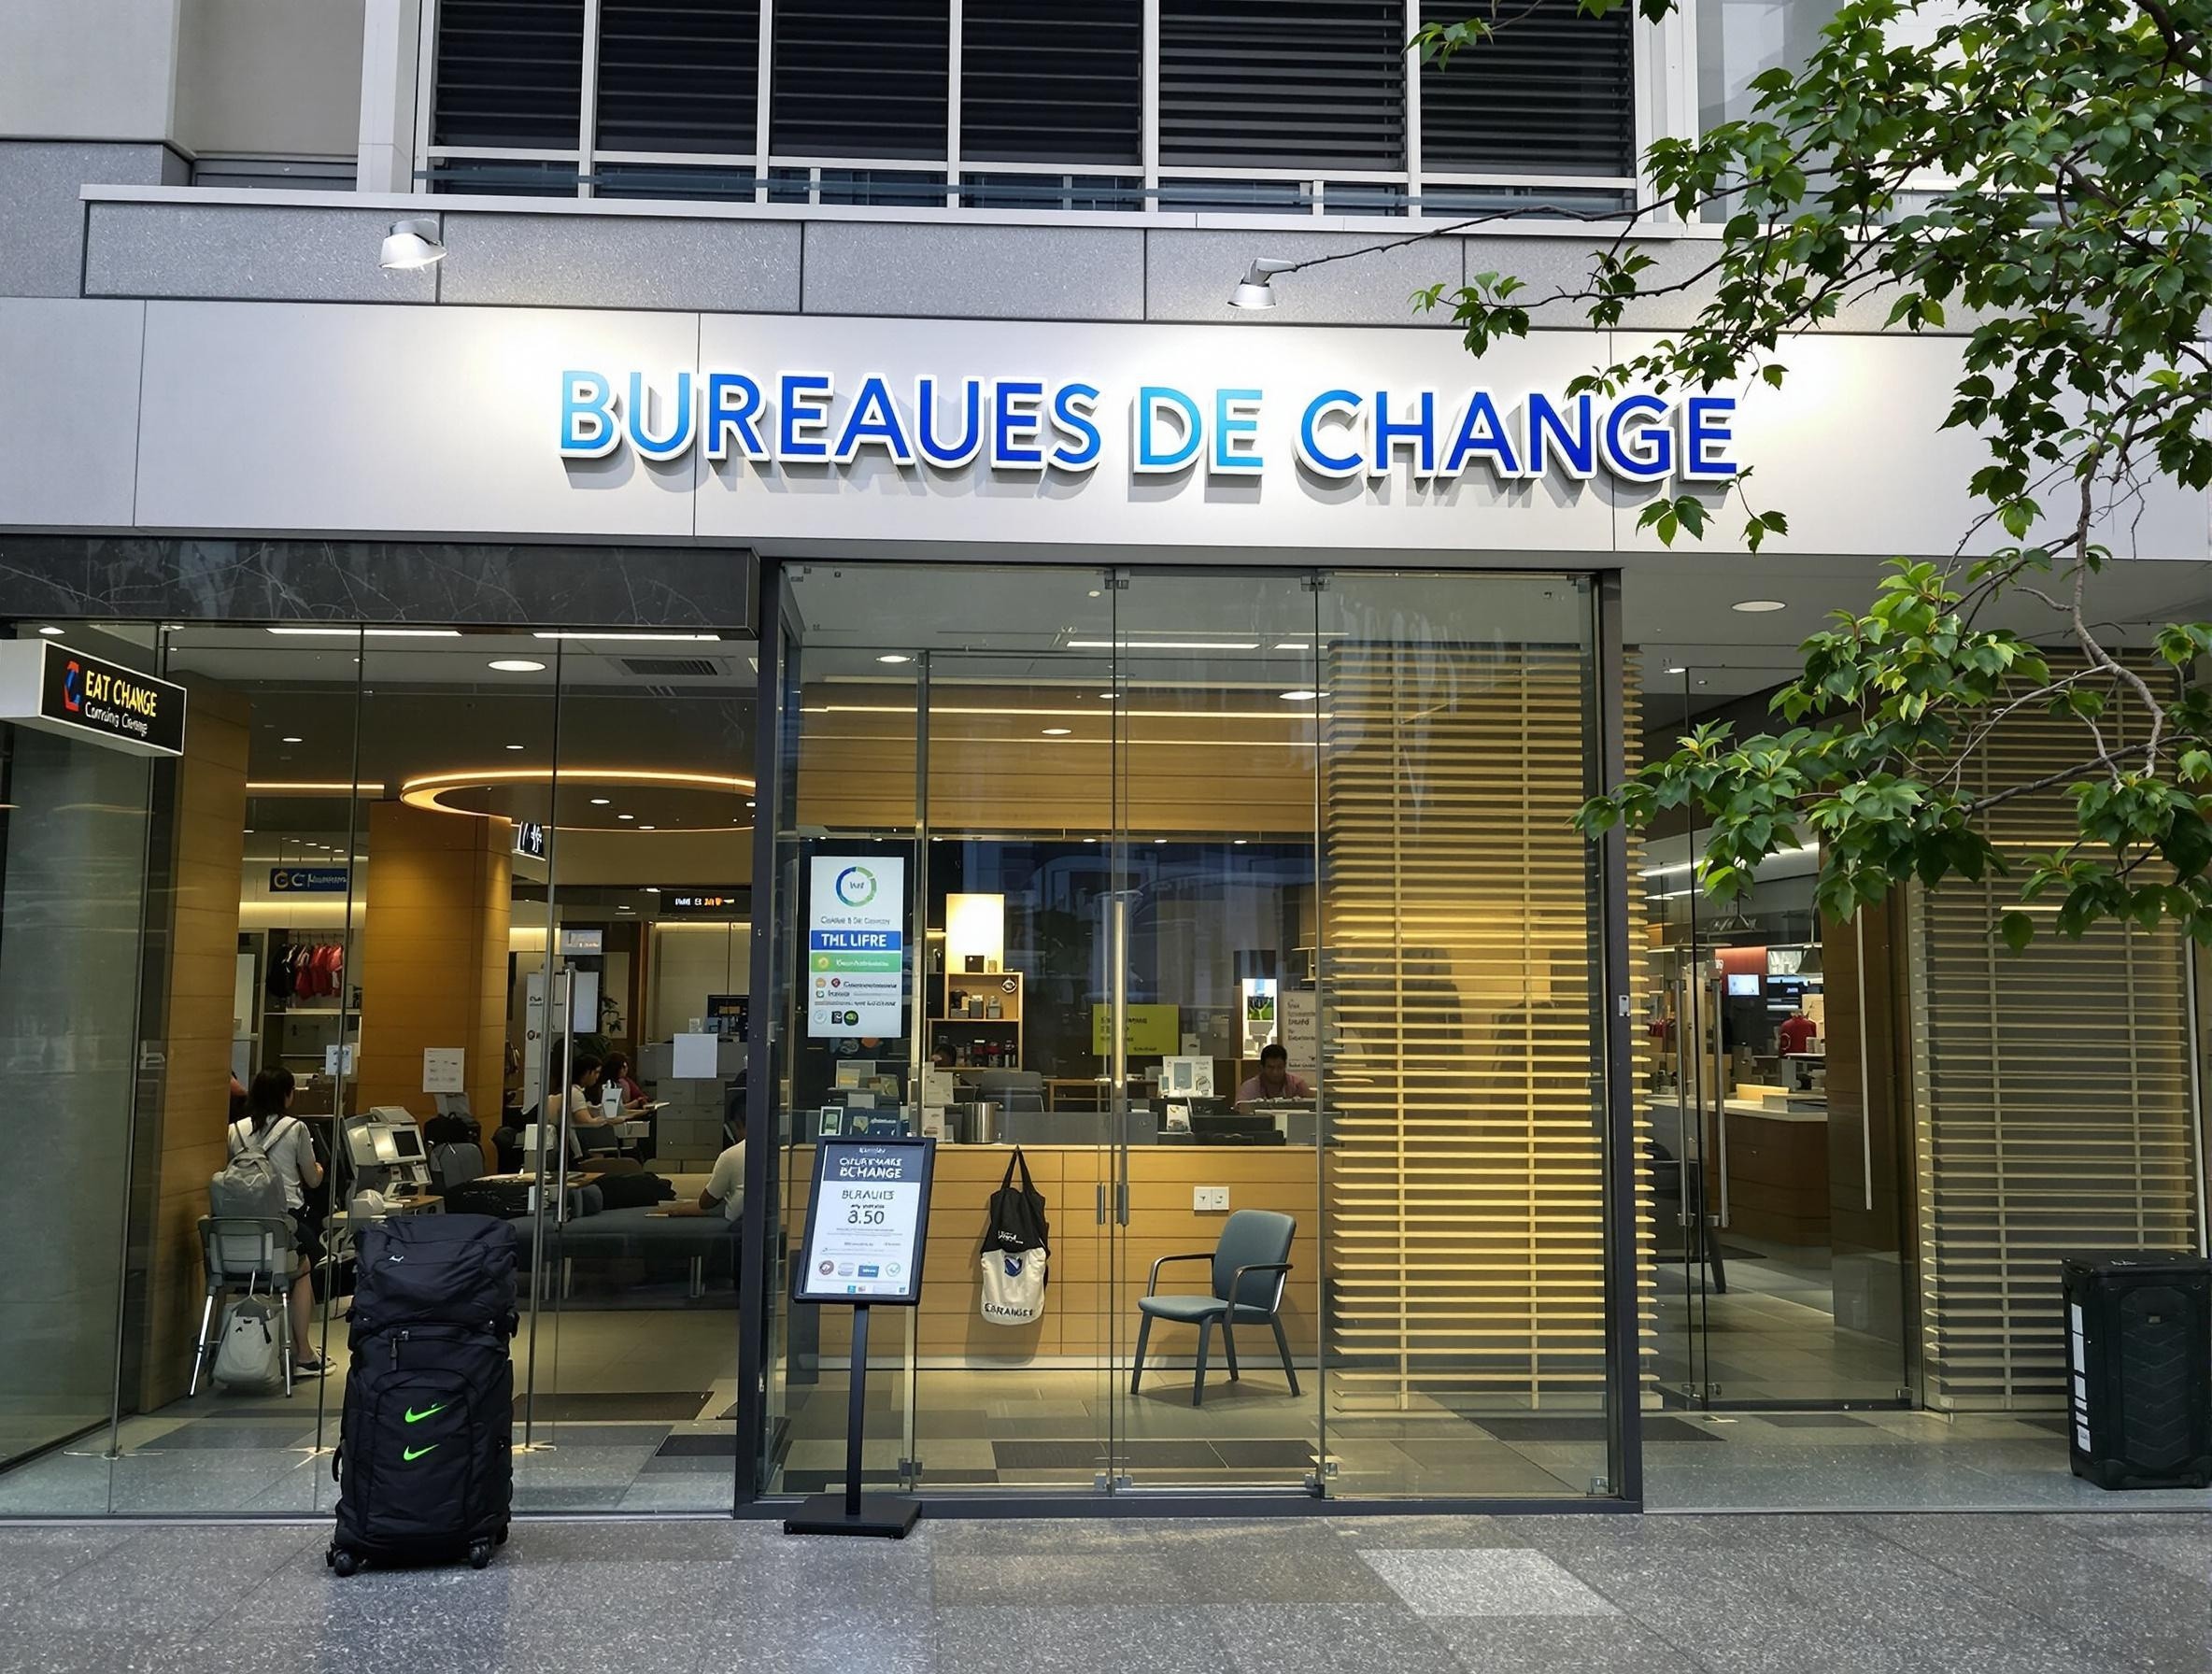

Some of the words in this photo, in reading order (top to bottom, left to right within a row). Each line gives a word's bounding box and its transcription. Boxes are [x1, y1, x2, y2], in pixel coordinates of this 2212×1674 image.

[560, 370, 1102, 465] BUREAUES
[1138, 385, 1264, 469] DE
[1299, 389, 1738, 478] CHANGE
[85, 670, 111, 702] EAT
[113, 679, 158, 717] CHANGE
[821, 933, 847, 947] THL
[850, 933, 887, 947] LIFRE
